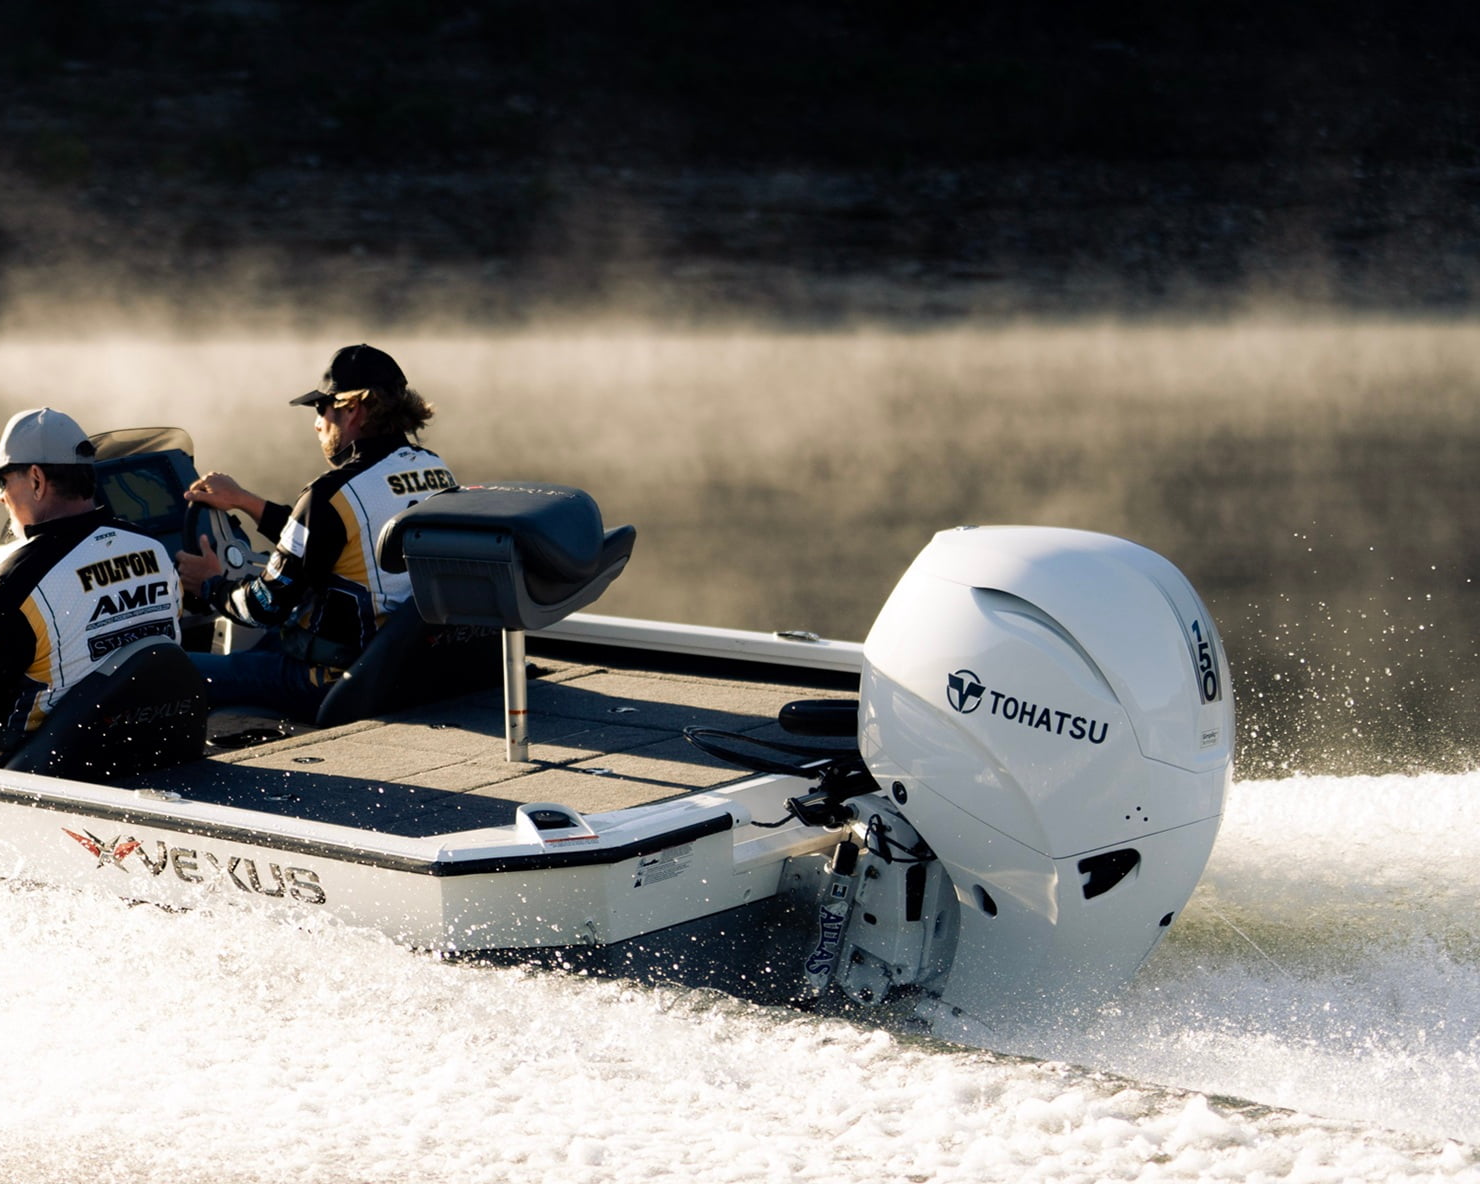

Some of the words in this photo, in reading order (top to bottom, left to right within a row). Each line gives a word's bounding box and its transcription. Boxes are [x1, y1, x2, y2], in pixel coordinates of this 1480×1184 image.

[76, 549, 160, 594] FULTON
[88, 580, 170, 623] AMP
[1191, 619, 1218, 702] 150
[990, 690, 1109, 744] TOHATSU
[127, 836, 327, 905] VEXUS
[805, 904, 845, 976] ATLAS
